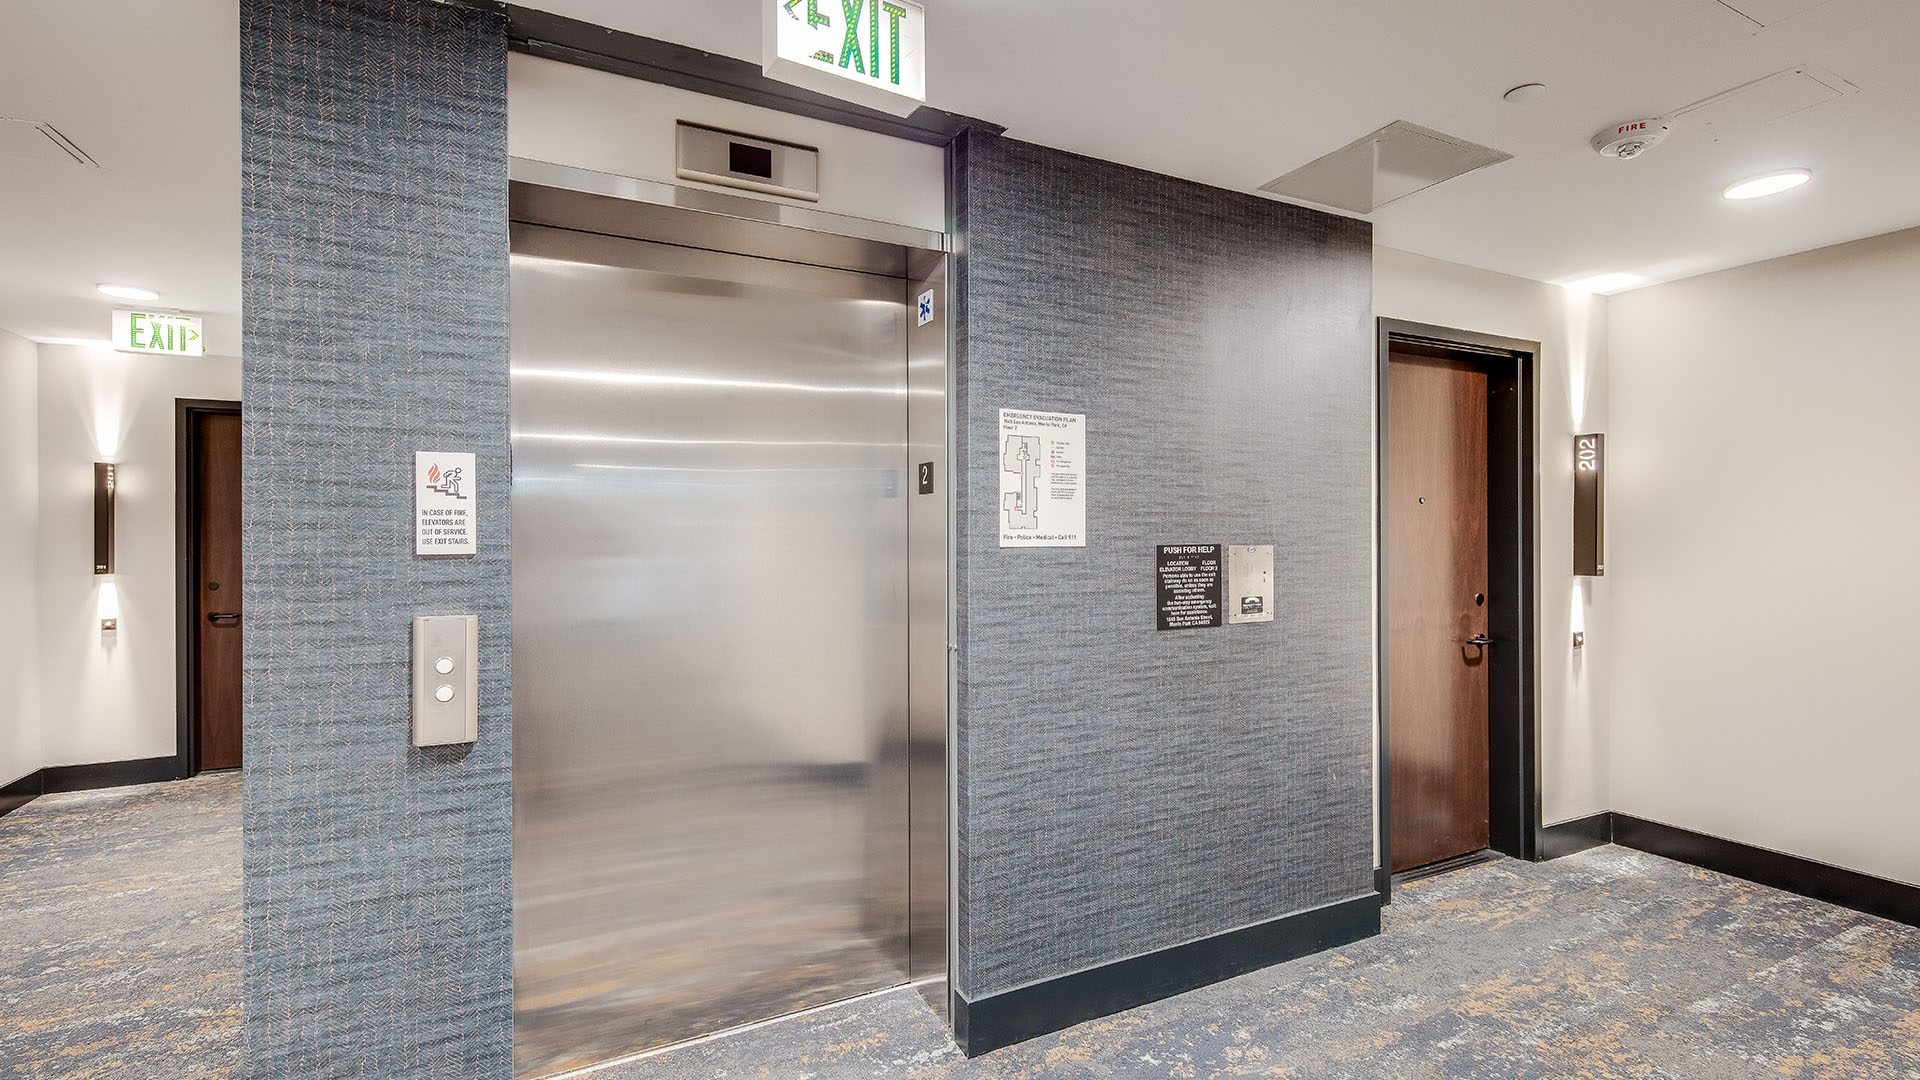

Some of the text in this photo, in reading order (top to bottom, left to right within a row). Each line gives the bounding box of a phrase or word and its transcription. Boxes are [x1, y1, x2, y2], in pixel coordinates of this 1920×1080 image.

[1618, 122, 1646, 134] FIRE
[130, 312, 190, 352] EXIT
[1579, 438, 1596, 471] 202
[922, 466, 928, 484] 2
